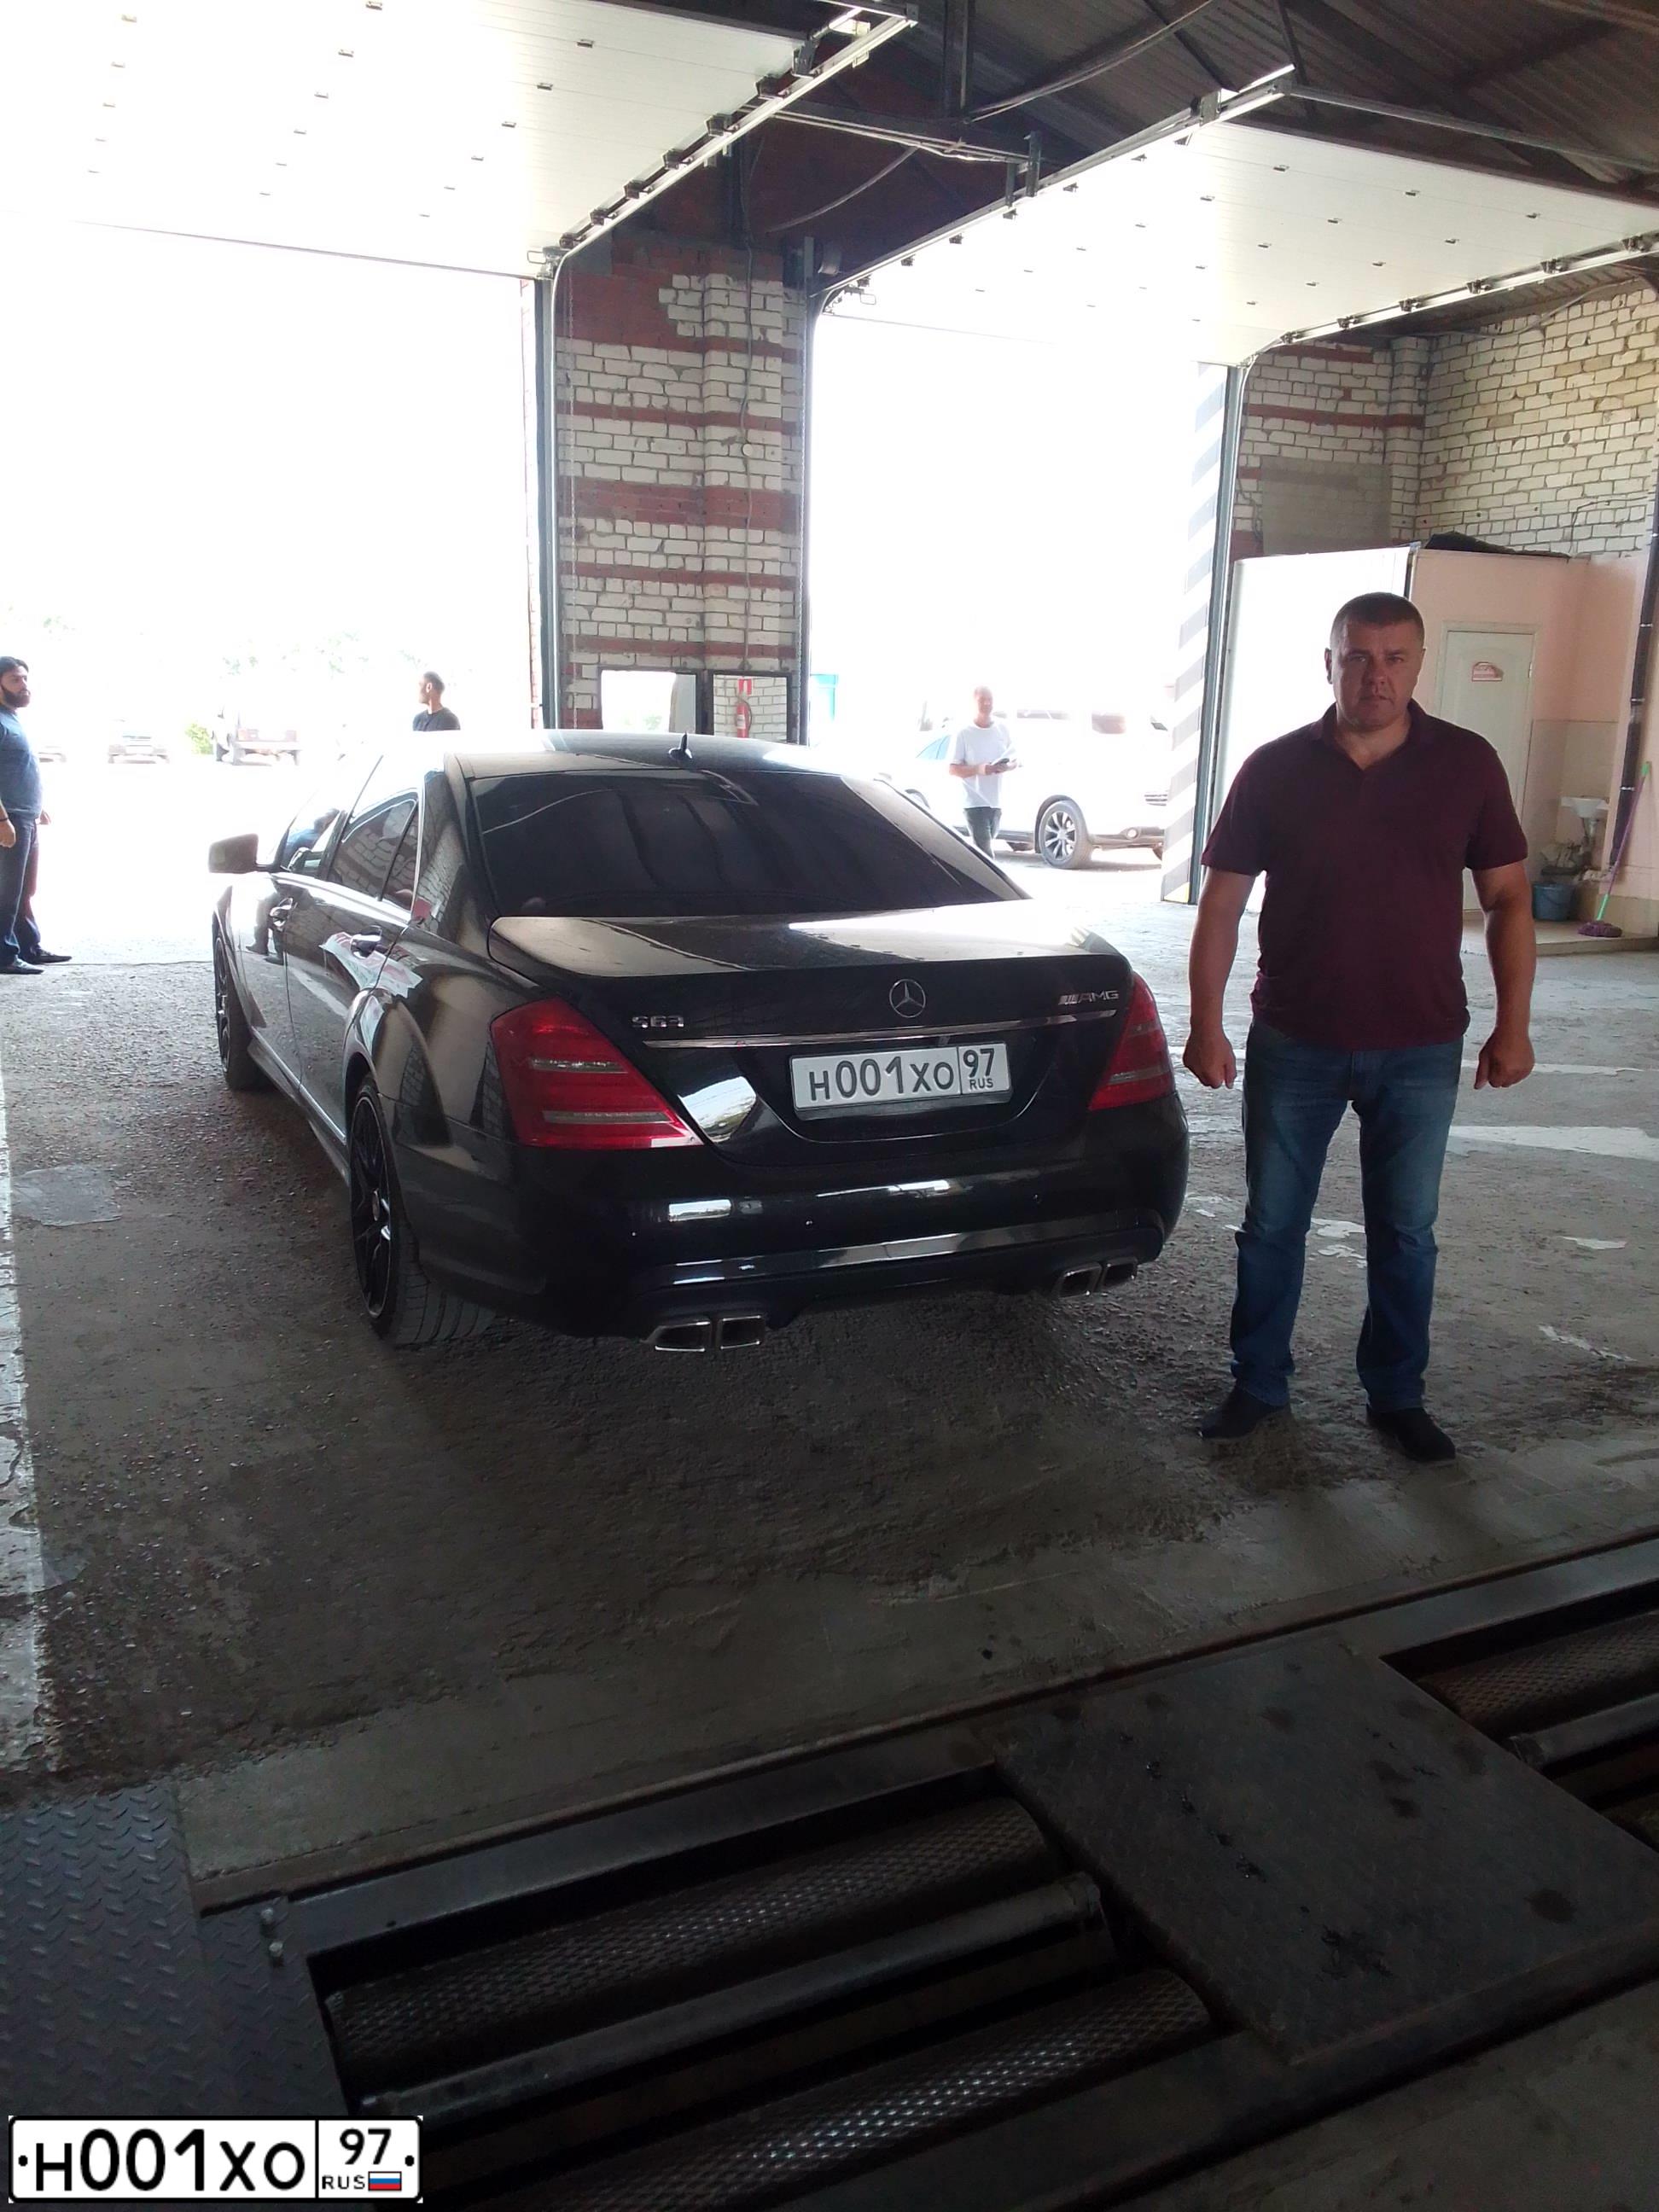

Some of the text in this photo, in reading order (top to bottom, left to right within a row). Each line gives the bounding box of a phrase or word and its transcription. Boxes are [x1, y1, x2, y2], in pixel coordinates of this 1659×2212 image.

[1076, 990, 1119, 1004] AMG
[963, 1048, 994, 1079] 97
[969, 1078, 994, 1090] RUS
